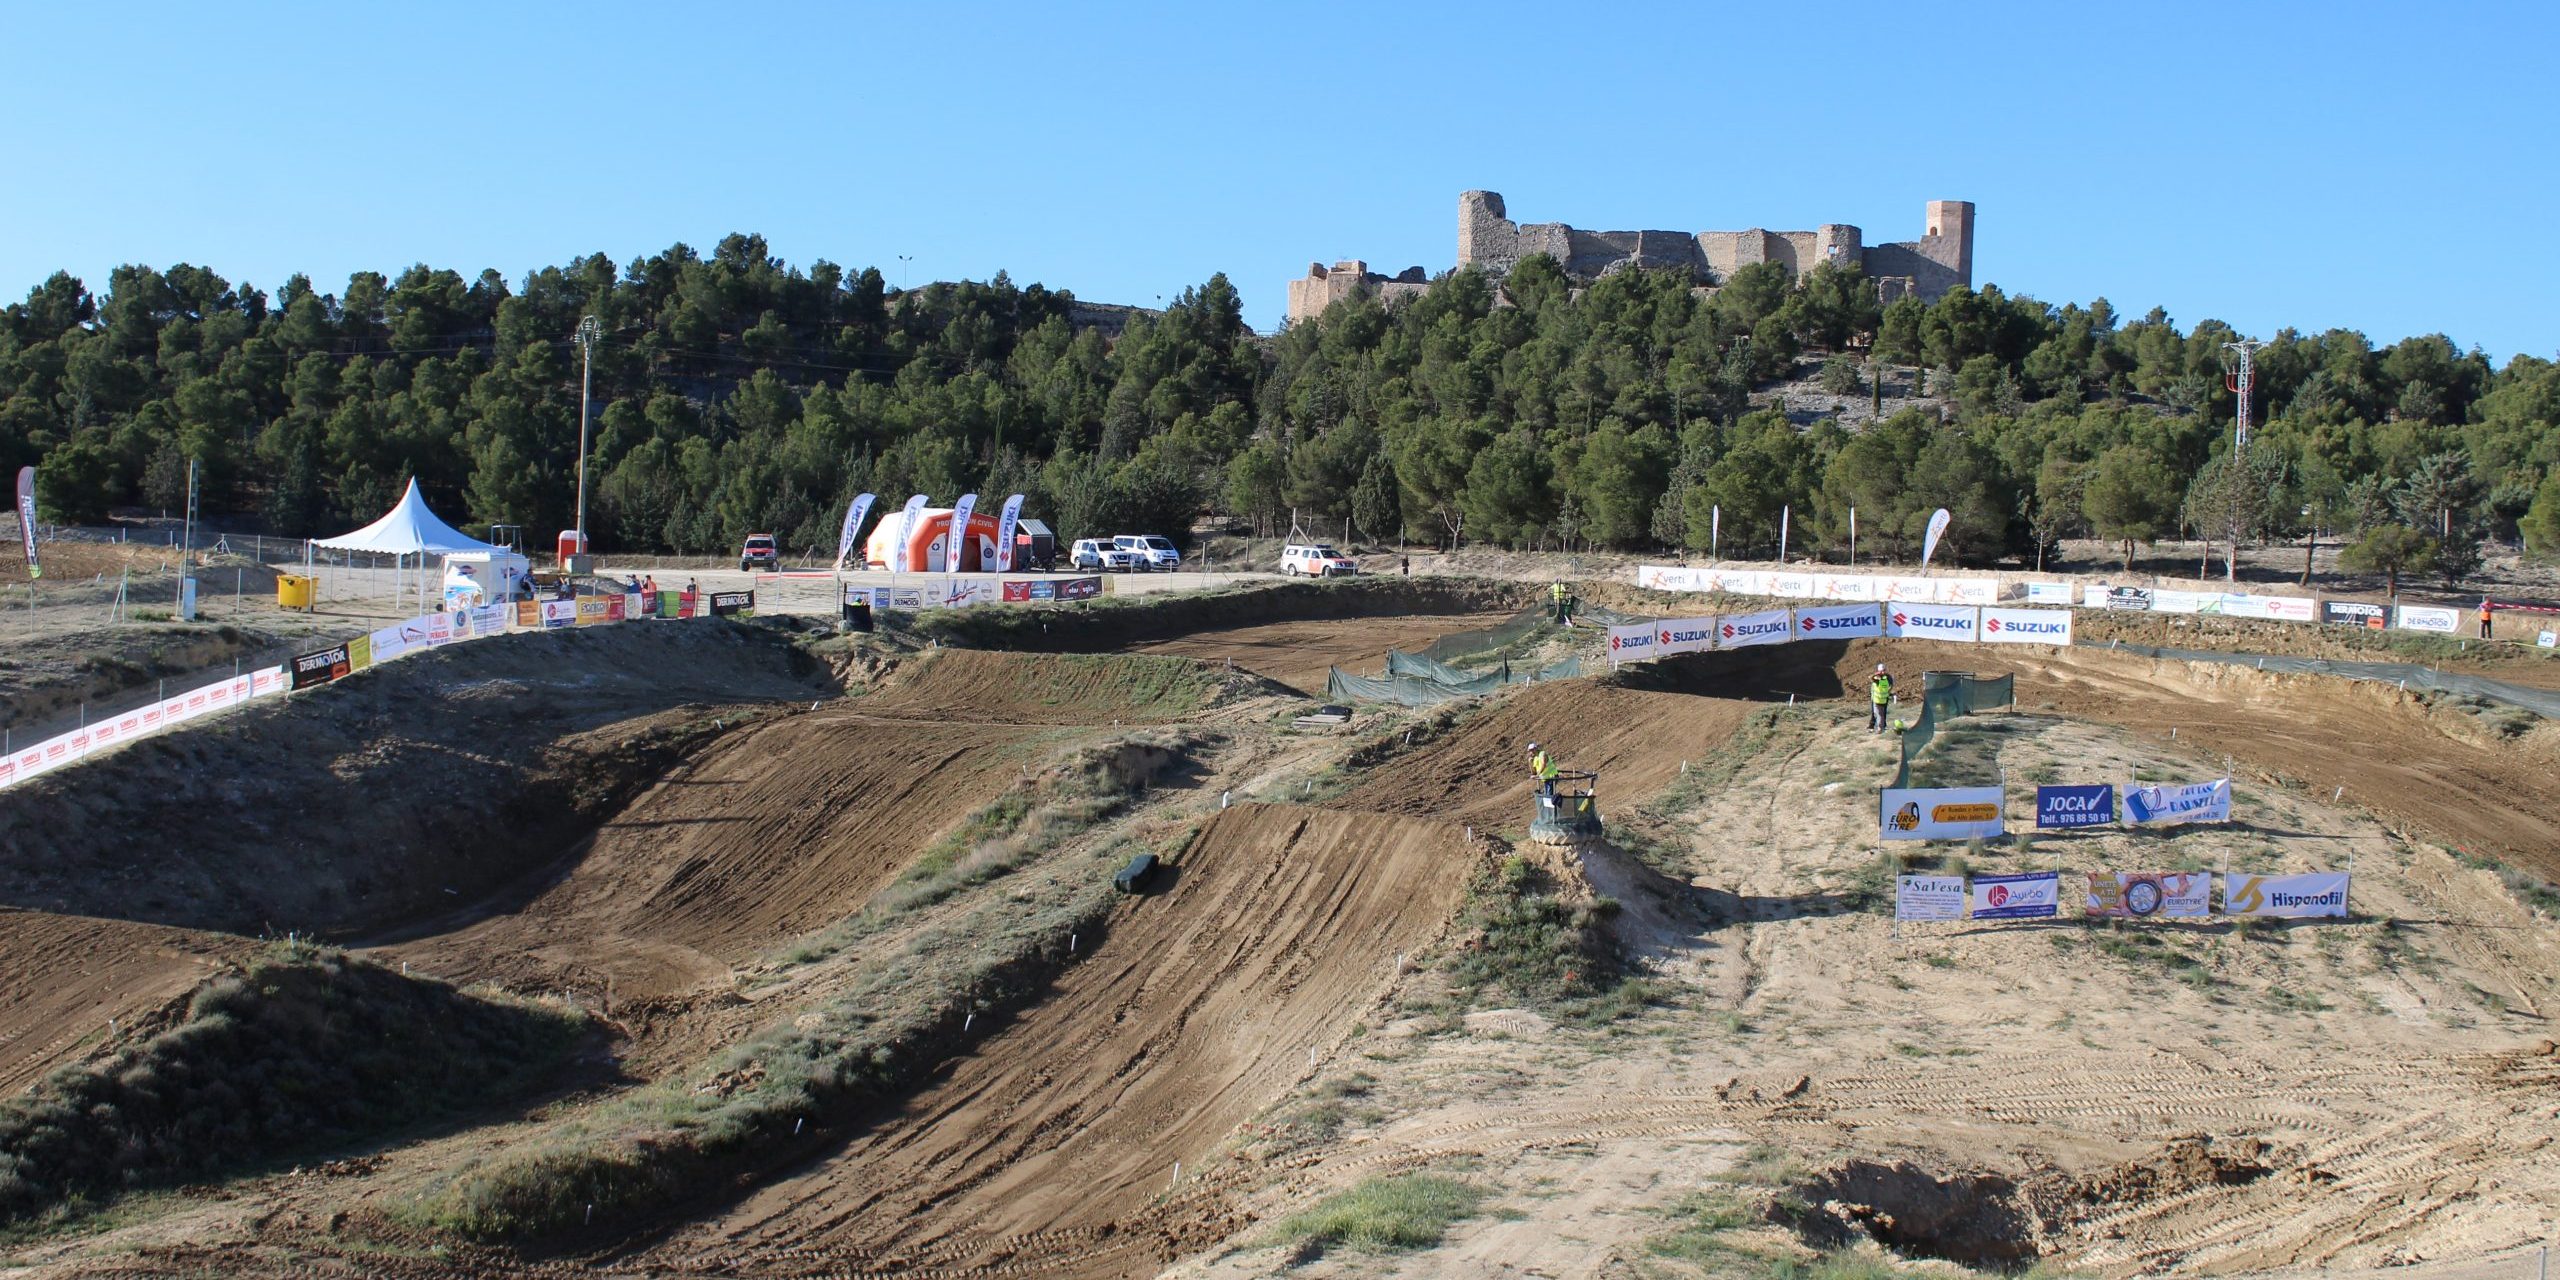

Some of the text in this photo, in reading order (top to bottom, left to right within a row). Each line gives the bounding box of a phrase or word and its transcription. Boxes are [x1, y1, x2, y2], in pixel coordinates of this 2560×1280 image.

[1002, 506, 1017, 549] SUZUKI
[1663, 575, 1685, 585] verti
[1838, 583, 1861, 593] verti
[1900, 585, 1922, 594] verti
[1962, 587, 1985, 596] verti
[716, 595, 750, 607] DERMOTOR
[2330, 604, 2384, 618] DERMOTOR
[1819, 616, 1877, 629] SUZUKI
[1911, 616, 1972, 630] SUZUKI
[2005, 621, 2065, 634] SUZUKI
[2407, 616, 2449, 627] DERMOTOR
[1737, 621, 1787, 636] SUZUKI
[1622, 635, 1653, 648] SUZUKI
[1673, 629, 1711, 642] SUZUKI
[299, 650, 346, 673] DERMOTOR
[253, 674, 270, 685] SIMPLY
[232, 681, 249, 691] SIMPLY
[210, 687, 228, 698] SIMPLY
[188, 694, 205, 705] SIMPLY
[166, 702, 184, 713] SIMPLY
[143, 709, 161, 720] SIMPLY
[120, 717, 138, 729] SIMPLY
[95, 725, 114, 737] SIMPLY
[71, 734, 90, 746] SIMPLY
[47, 742, 66, 755] SIMPLY
[21, 751, 41, 764] SIMPLY
[2045, 796, 2087, 812] JOCA
[1890, 814, 1917, 823] EURO
[2040, 812, 2110, 824] Telf. 976 88 50 91
[1888, 823, 1910, 831] TYRE
[1912, 880, 1961, 893] SaVesa
[2107, 888, 2116, 896] TU
[2167, 898, 2202, 906] EUROTYRE
[2272, 891, 2343, 908] Hispanofil
